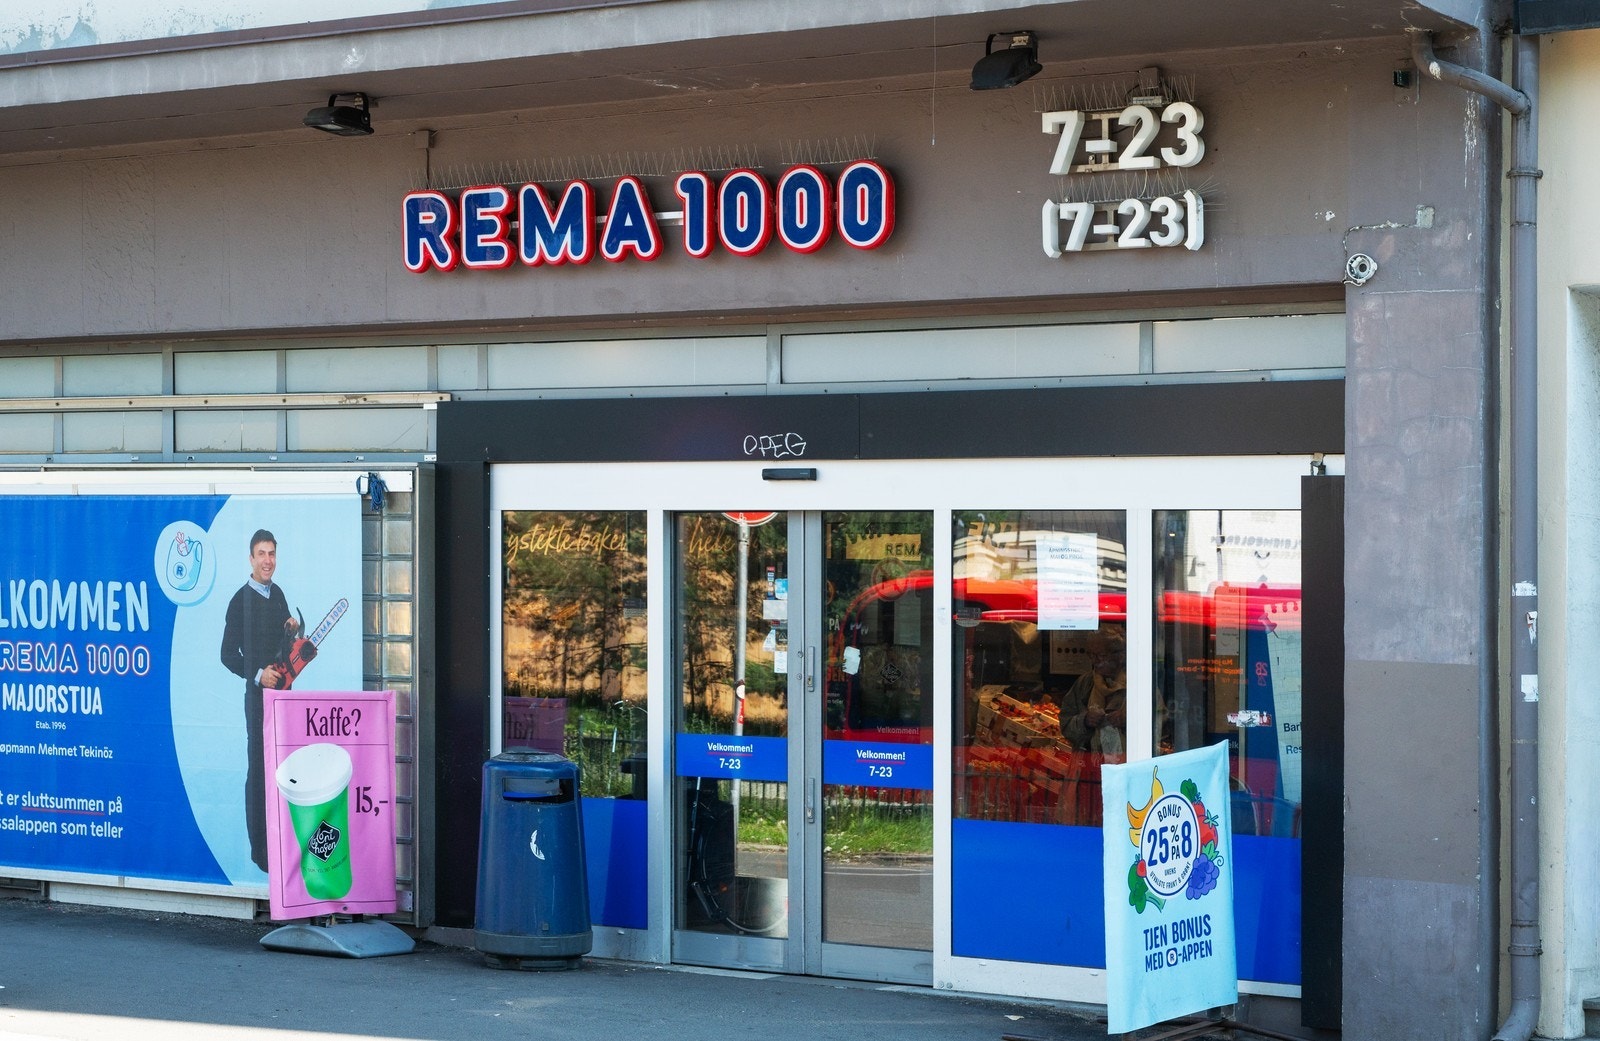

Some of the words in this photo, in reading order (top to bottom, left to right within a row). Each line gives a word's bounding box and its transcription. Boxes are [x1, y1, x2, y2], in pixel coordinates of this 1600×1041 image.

[1042, 101, 1206, 175] 7-23
[402, 174, 664, 274] REMA
[674, 159, 897, 259] 1000
[1042, 189, 1205, 258] (7-23)
[311, 618, 332, 644] REMA
[330, 601, 347, 622] 1000
[0, 640, 78, 674] REMA
[85, 643, 150, 676] 1000
[2, 682, 103, 715] MAJORSTUA
[35, 720, 51, 730] Etab.
[52, 721, 67, 731] 1996
[306, 707, 362, 737] Kaffe?
[38, 742, 77, 757] Mehmet
[79, 745, 114, 759] Tekinöz
[707, 742, 753, 753] Velkommen!
[856, 749, 906, 761] Velkommen!
[719, 757, 742, 770] 7-23
[869, 765, 893, 778] 7-23
[6, 793, 20, 806] er
[21, 790, 104, 812] sluttsummen
[108, 795, 123, 815] på
[355, 786, 389, 817] 15,-
[1157, 803, 1182, 822] BONUS
[60, 821, 88, 837] som
[90, 821, 124, 839] teller
[1147, 825, 1169, 867] 25
[1170, 824, 1180, 843] %
[1181, 820, 1192, 858] 8
[1143, 923, 1168, 951] TJEN
[1171, 913, 1212, 944] BONUS
[1145, 951, 1164, 973] MED
